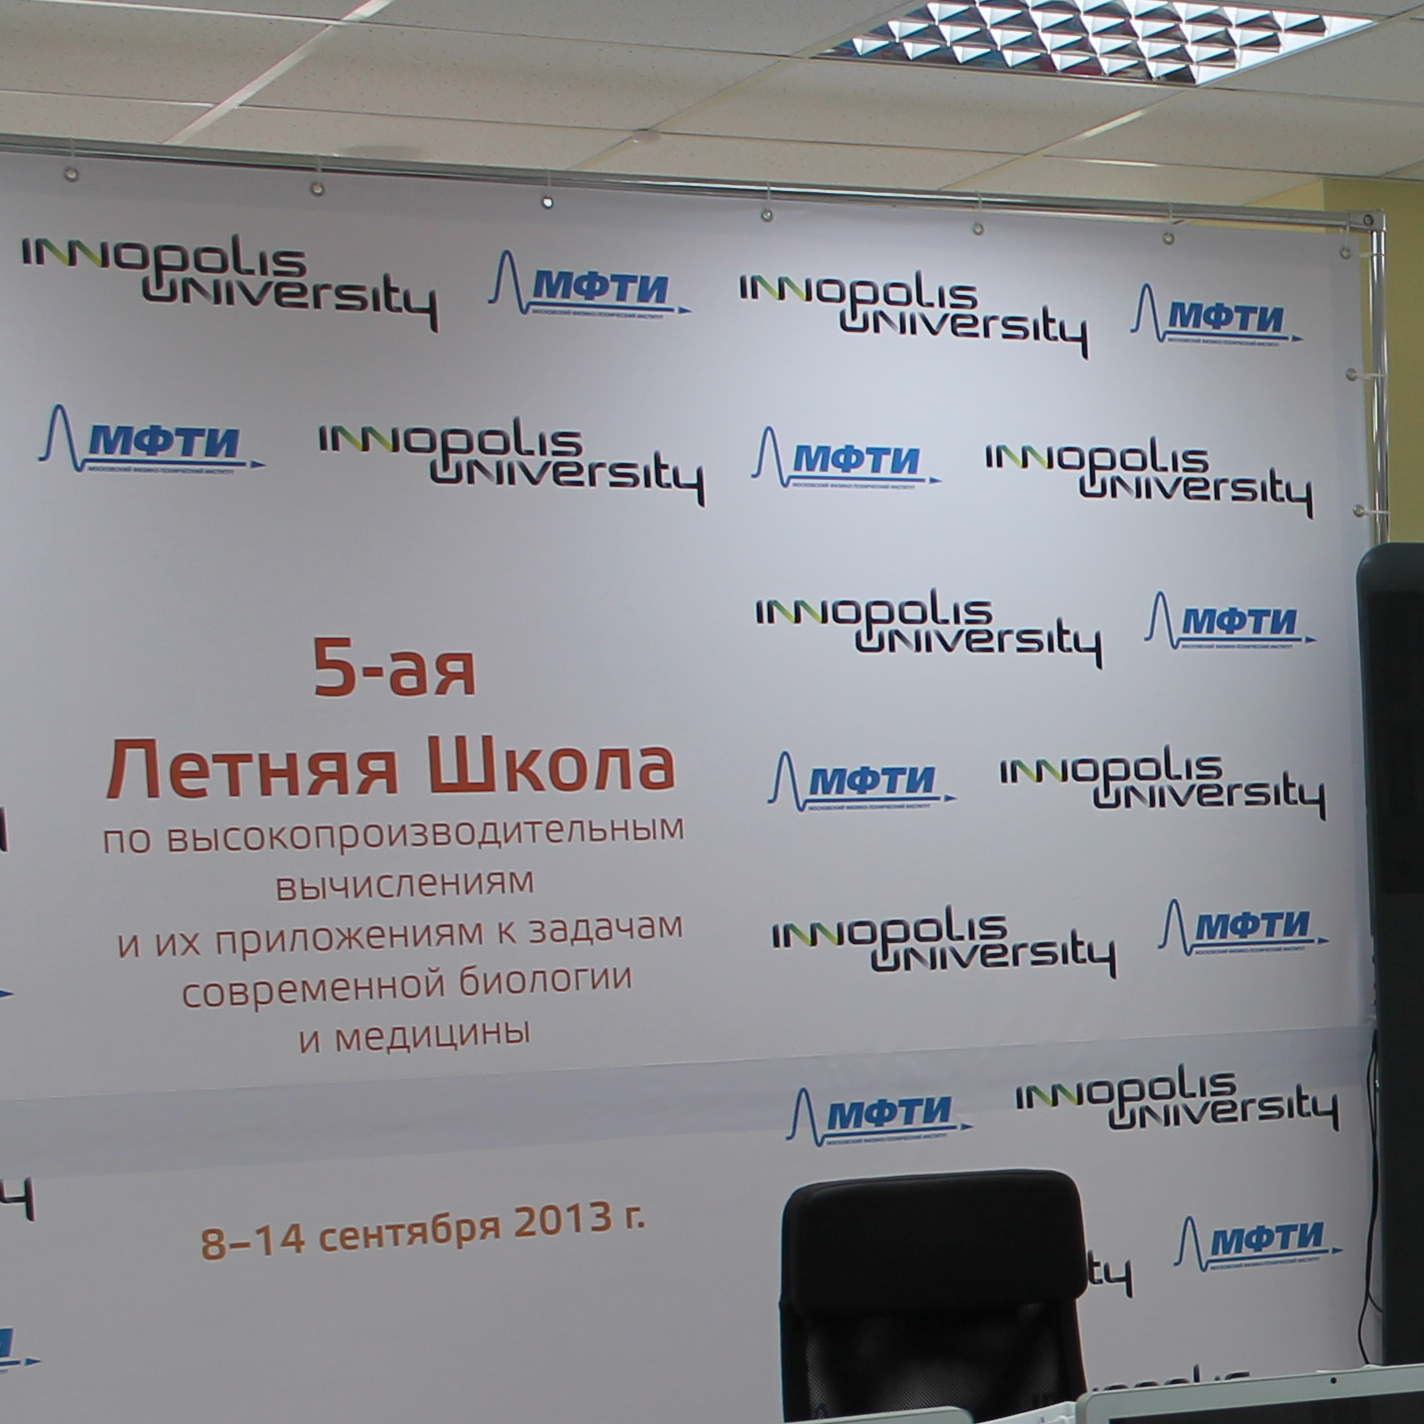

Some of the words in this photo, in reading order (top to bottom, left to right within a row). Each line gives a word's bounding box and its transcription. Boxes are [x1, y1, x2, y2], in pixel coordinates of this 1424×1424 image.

[531, 269, 669, 303] МФТИ
[1168, 301, 1285, 333] МФТИ
[89, 424, 241, 458] МФТИ
[793, 445, 920, 475] МФТИ
[1182, 607, 1297, 634] МФТИ
[313, 636, 477, 698] 5-ая
[105, 737, 399, 800] Летняя
[427, 735, 675, 793] Школа
[808, 766, 935, 795] МФТИ
[103, 826, 151, 854] по
[168, 816, 686, 856] высокопроизводительным
[275, 870, 534, 902] вычислениям
[118, 932, 140, 958] и
[155, 930, 200, 957] их
[217, 921, 484, 961] приложениям
[498, 919, 517, 945] к
[528, 914, 683, 947] задачам
[1195, 911, 1310, 939] МФТИ
[181, 968, 446, 1012] современной
[458, 964, 633, 997] биологии
[299, 1029, 320, 1054] и
[335, 1020, 531, 1055] медицины
[827, 1096, 952, 1130] МФТИ
[200, 1223, 306, 1261] 8–14
[319, 1211, 501, 1252] сентября
[513, 1200, 612, 1239] 2013
[624, 1204, 646, 1230] г.
[1210, 1221, 1325, 1254] МФТИ
